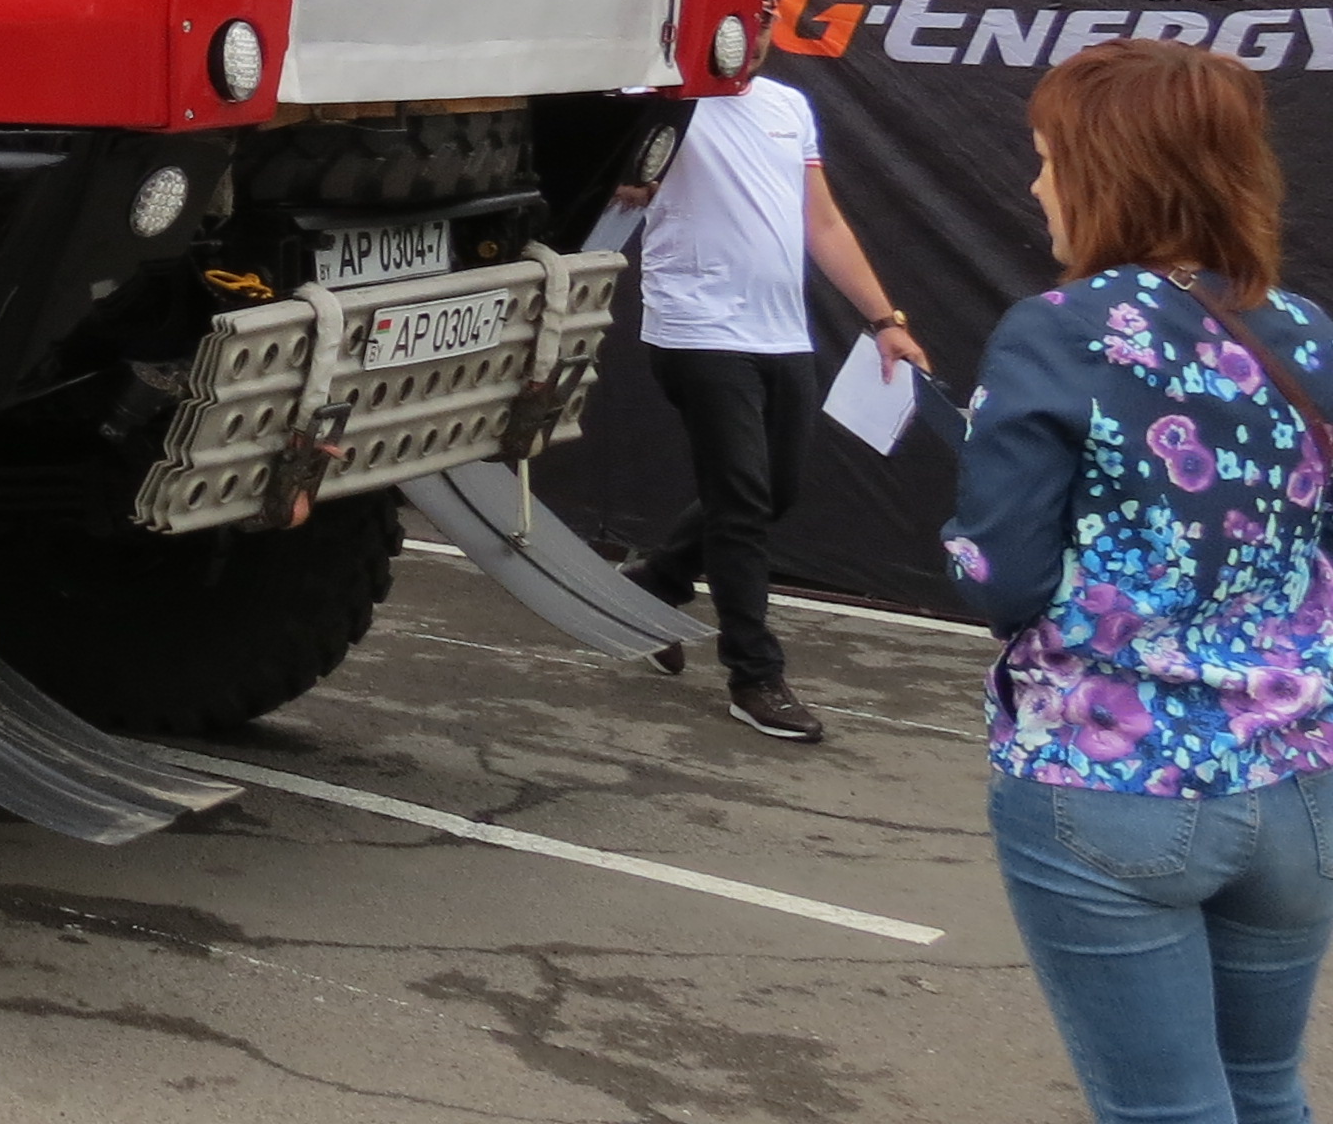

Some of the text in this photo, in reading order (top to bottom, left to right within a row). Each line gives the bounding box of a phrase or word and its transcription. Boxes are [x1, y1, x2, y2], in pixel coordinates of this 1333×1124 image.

[339, 232, 372, 278] AP
[379, 222, 444, 272] 0304-7
[390, 313, 431, 361] AP
[433, 299, 506, 352] 0304-7
